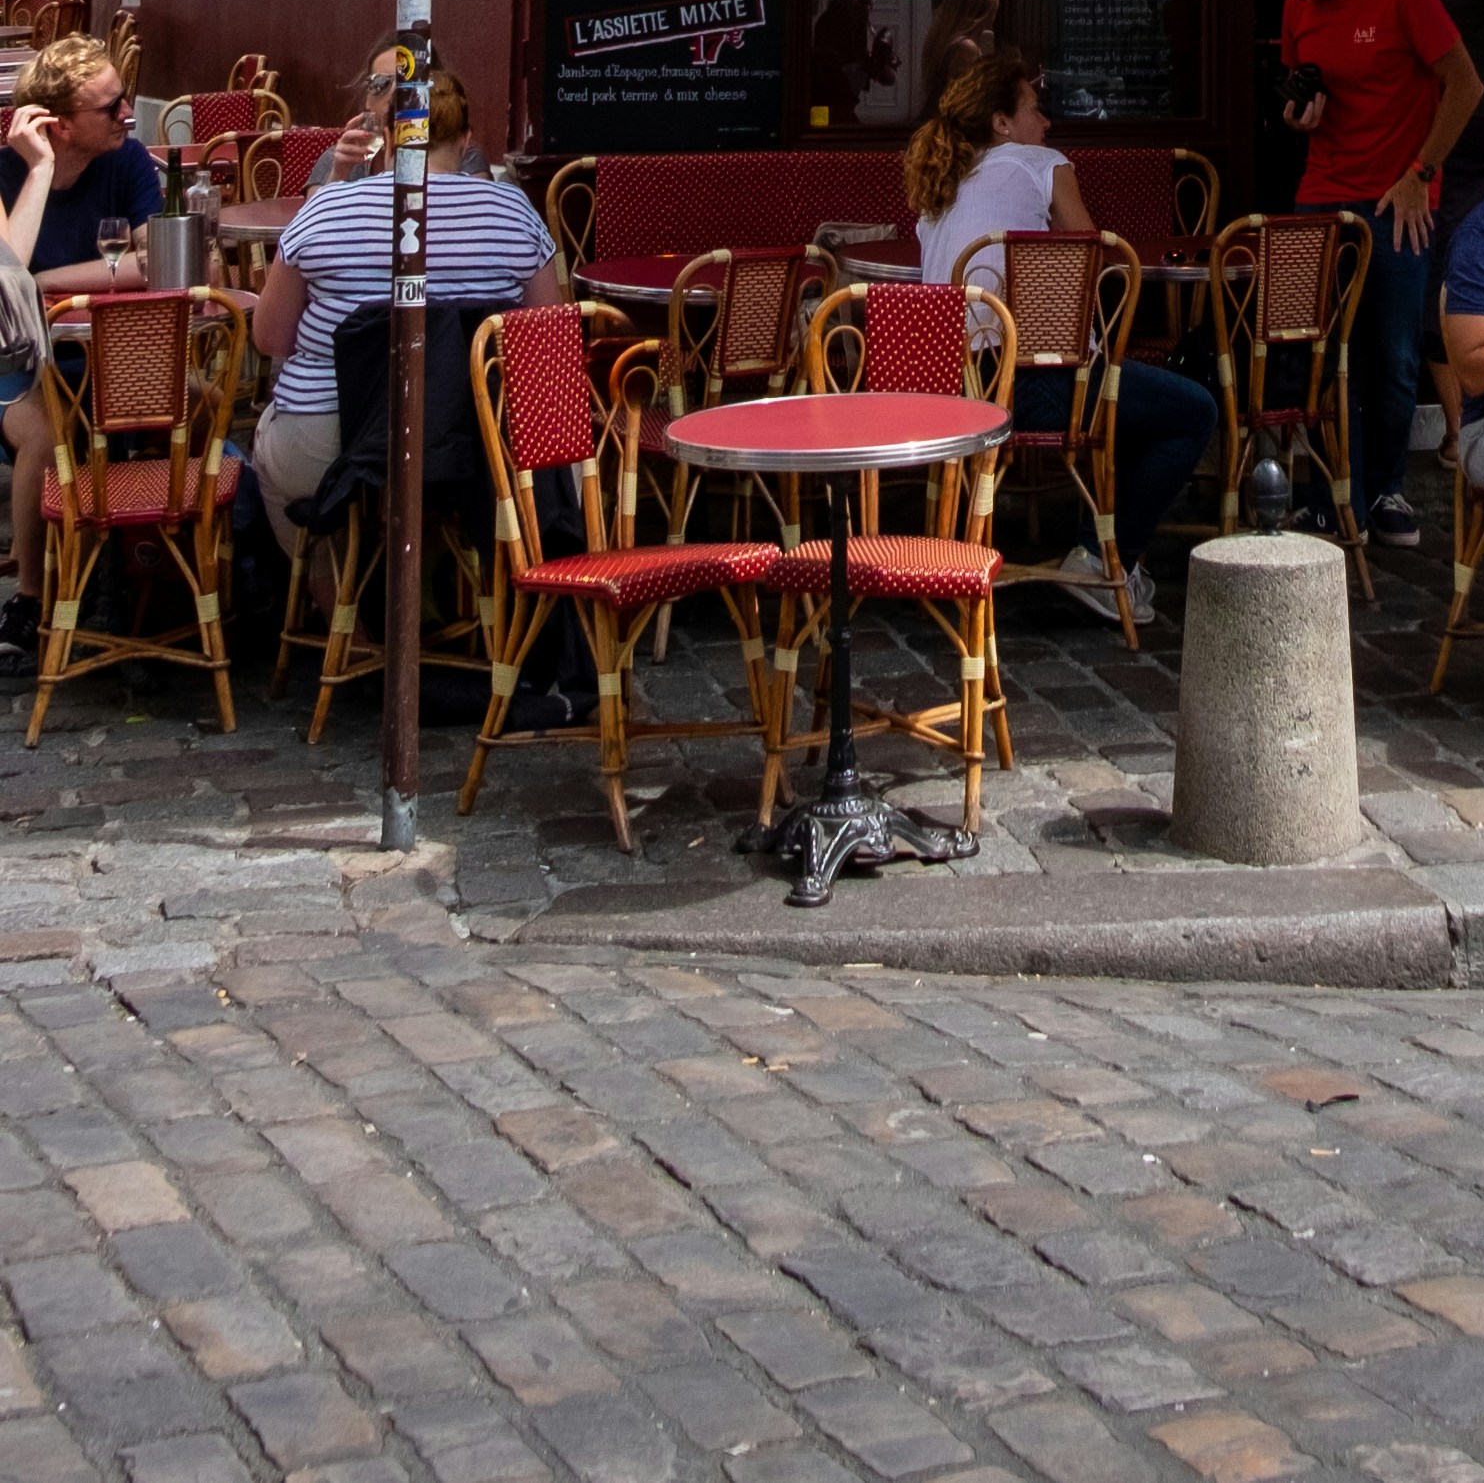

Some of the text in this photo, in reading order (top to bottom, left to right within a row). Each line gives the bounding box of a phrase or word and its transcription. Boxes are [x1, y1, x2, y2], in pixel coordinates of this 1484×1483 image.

[574, 9, 671, 46] L'ASSIETTE
[557, 63, 741, 80] Jambon terrine
[556, 86, 748, 105] Cured pork terrine & mix cheese
